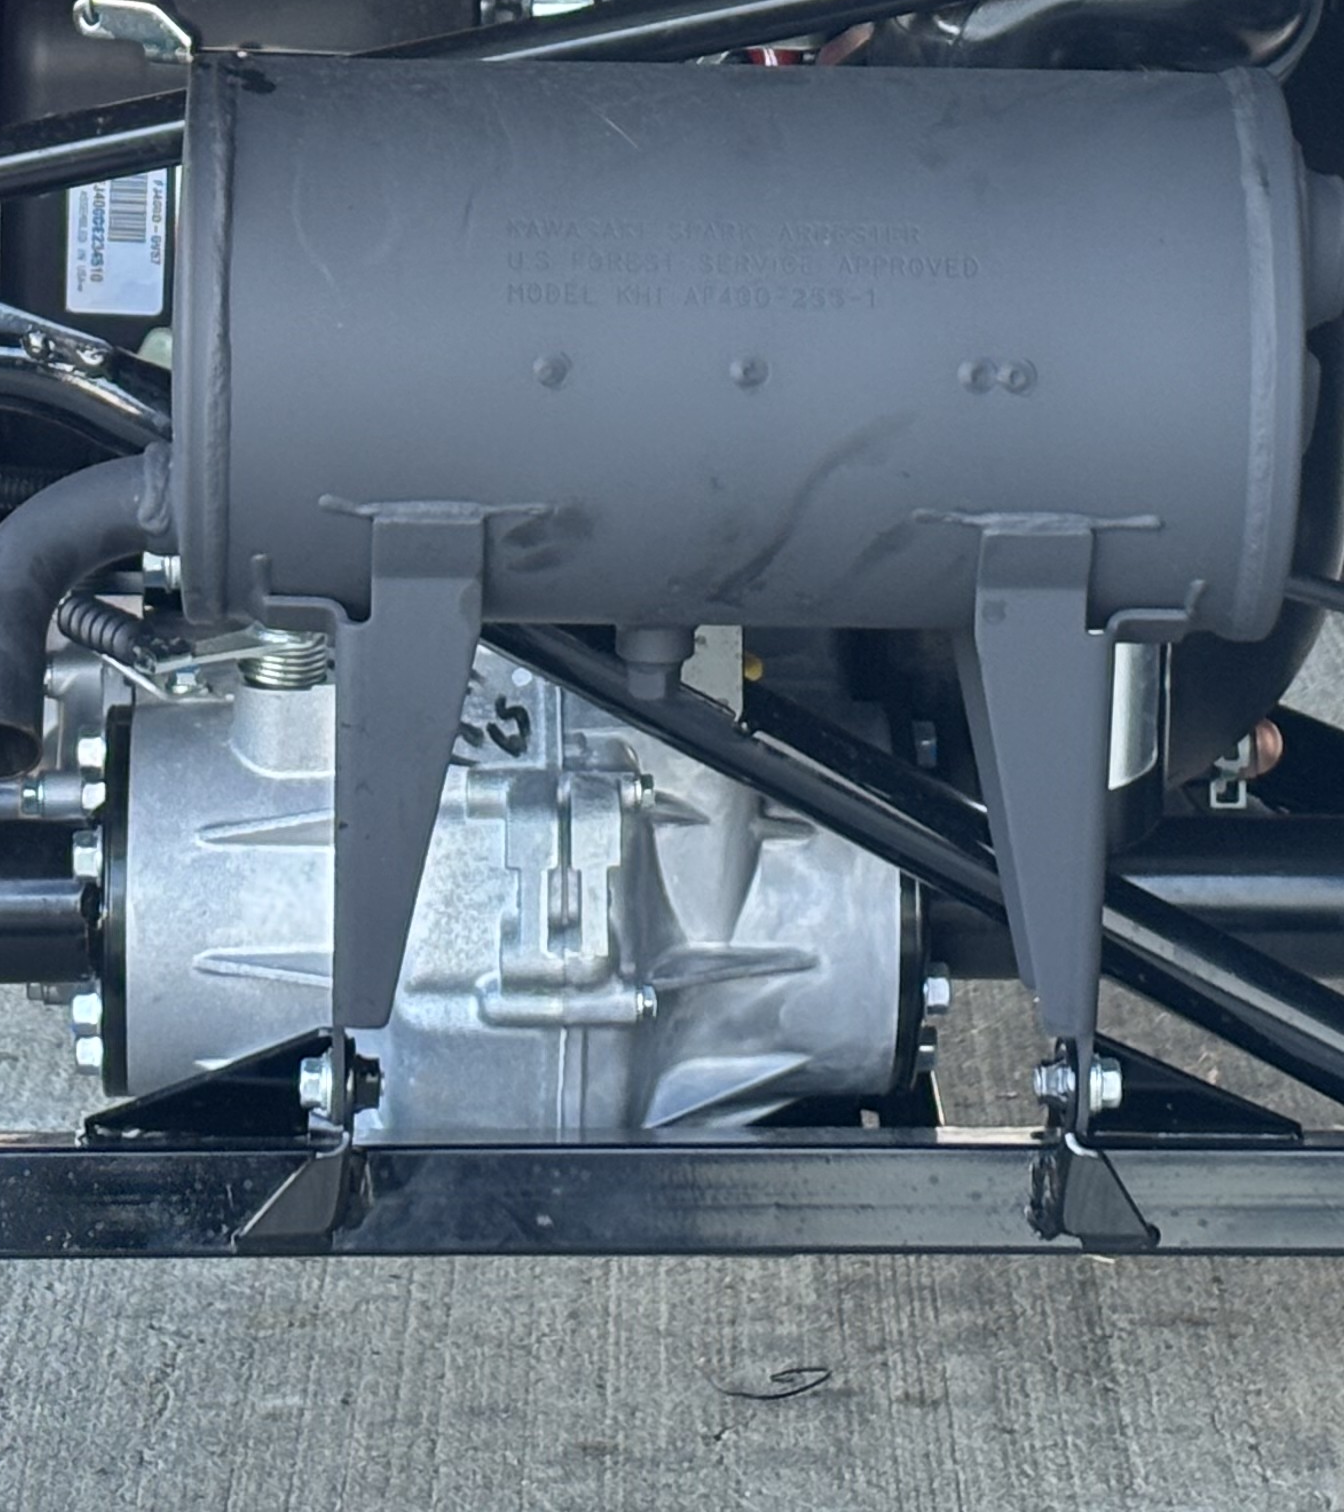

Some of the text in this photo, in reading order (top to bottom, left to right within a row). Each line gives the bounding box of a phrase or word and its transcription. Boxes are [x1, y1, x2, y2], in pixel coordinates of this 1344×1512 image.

[506, 218, 644, 240] KAWASAKI
[669, 219, 754, 242] SPARK
[572, 250, 671, 273] FOREST
[699, 252, 813, 276] SERVICE
[839, 254, 979, 279] APPROVED
[506, 282, 598, 305] MODEL
[616, 284, 662, 307] KHI
